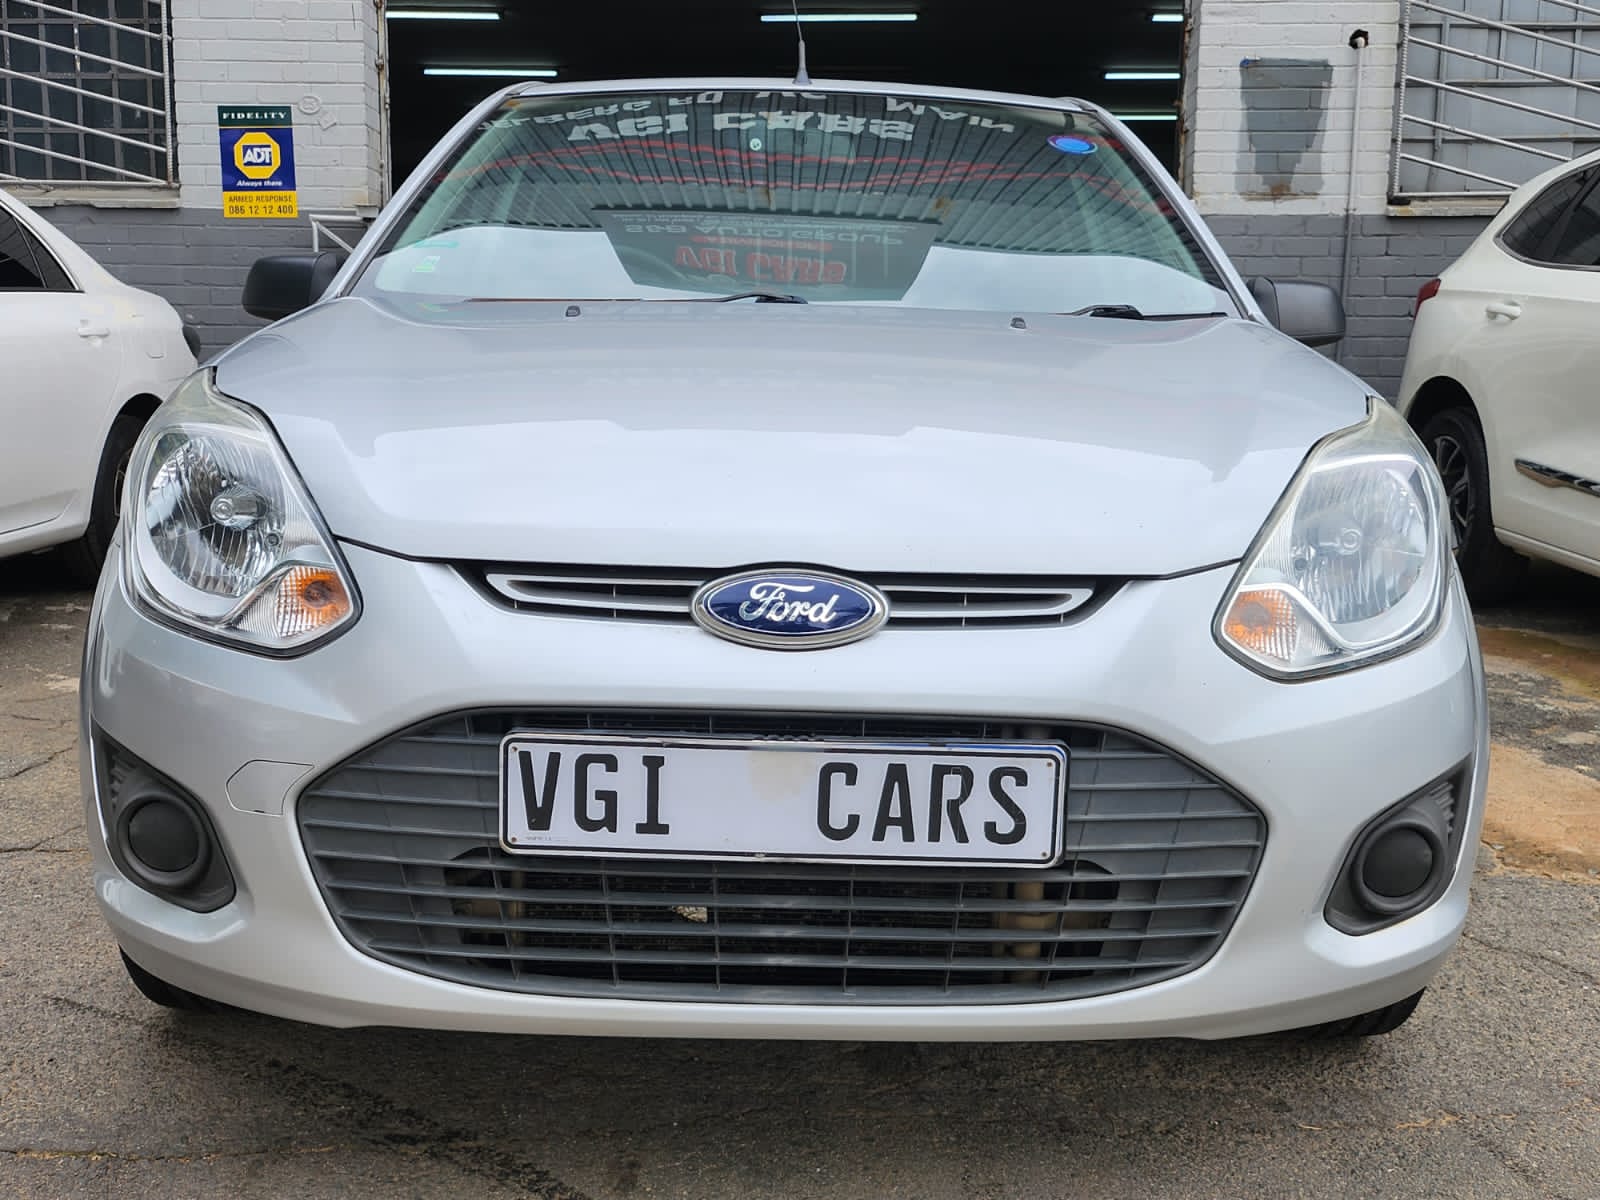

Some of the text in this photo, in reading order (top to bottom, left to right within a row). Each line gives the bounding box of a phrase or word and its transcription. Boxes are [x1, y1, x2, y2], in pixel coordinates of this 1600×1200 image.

[222, 111, 288, 120] FIDELITY
[243, 147, 273, 164] ADT
[236, 180, 262, 188] Always
[228, 195, 292, 203] ARMED RESPONSE
[249, 206, 260, 214] 12
[263, 206, 274, 214] 12
[739, 582, 840, 623] Ford
[518, 751, 1028, 845] VGI CARS
